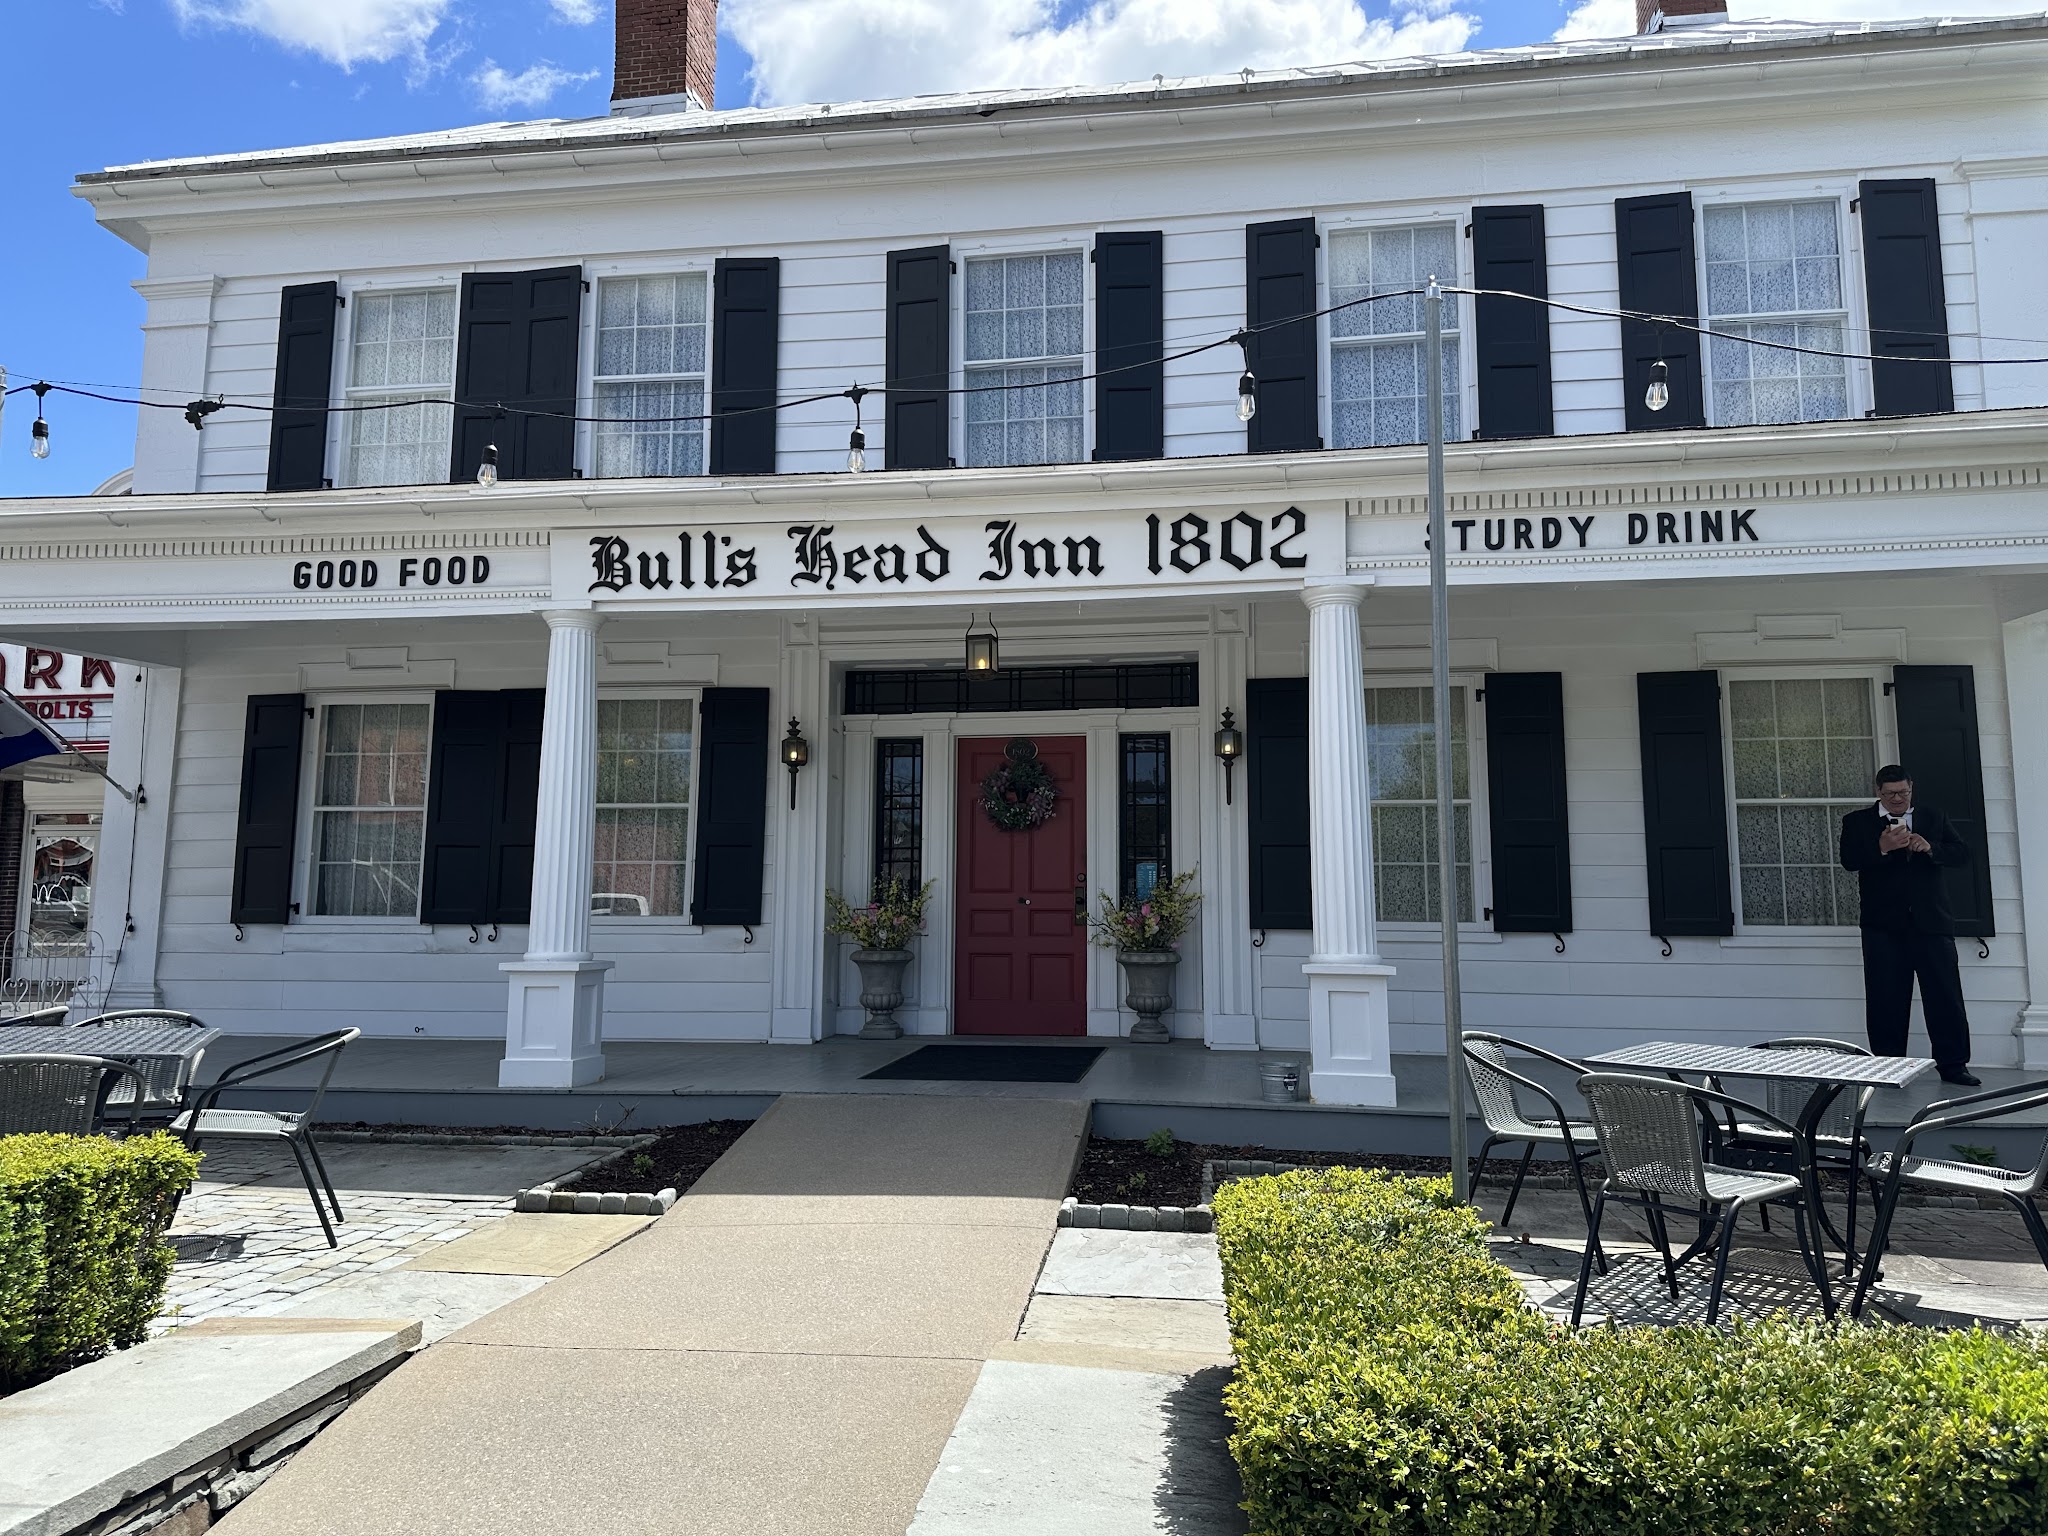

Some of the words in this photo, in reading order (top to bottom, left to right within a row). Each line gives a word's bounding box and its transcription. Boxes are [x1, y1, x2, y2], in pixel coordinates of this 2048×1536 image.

[588, 530, 758, 594] Bull's
[787, 524, 951, 591] Head
[978, 519, 1105, 580] Inn
[1145, 506, 1307, 576] 1802
[1424, 516, 1595, 551] TURDY
[1627, 508, 1759, 545] DRINK
[293, 559, 378, 590] GOOD
[399, 555, 490, 587] FOOD
[0, 646, 115, 690] RK
